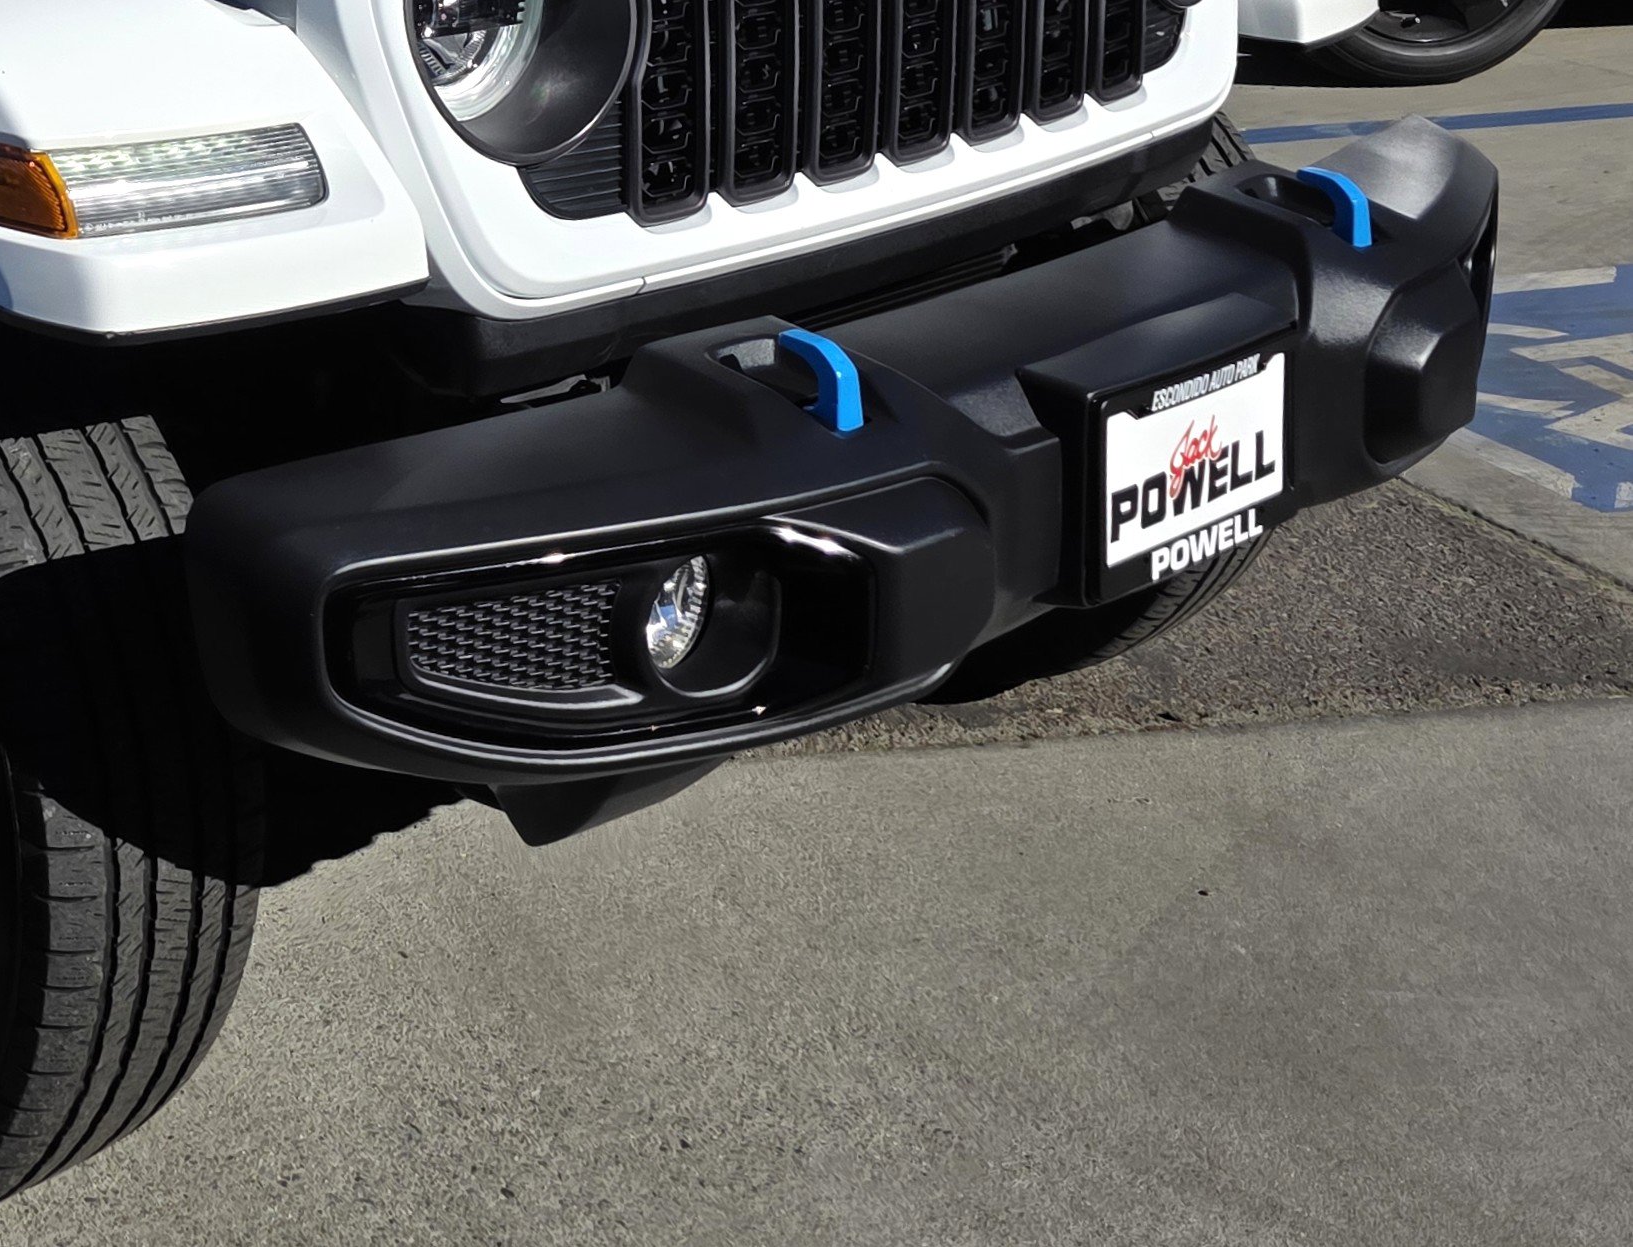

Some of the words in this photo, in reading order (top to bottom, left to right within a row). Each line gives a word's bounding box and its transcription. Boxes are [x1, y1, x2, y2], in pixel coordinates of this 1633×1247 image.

[1151, 373, 1210, 412] ESCONDIDO
[1208, 363, 1235, 392] AUTO
[1234, 353, 1261, 382] PARK
[1110, 430, 1276, 543] POWELL
[1169, 414, 1222, 499] Jack
[1151, 508, 1263, 582] POWELL
